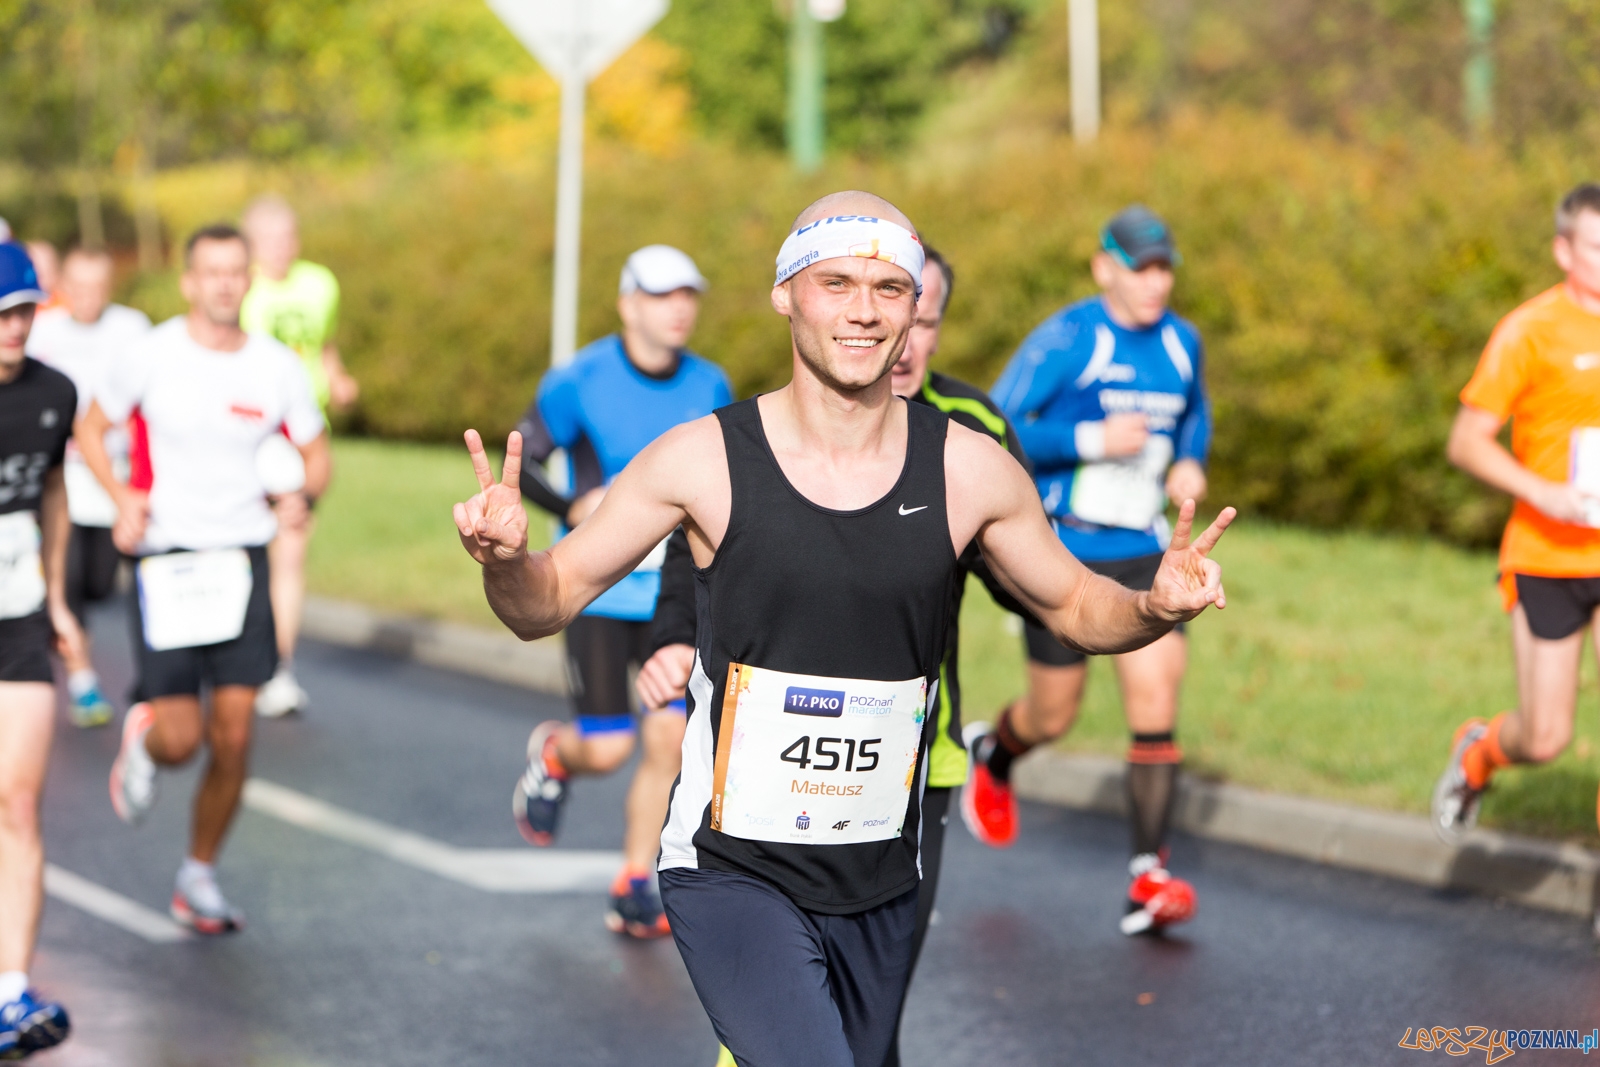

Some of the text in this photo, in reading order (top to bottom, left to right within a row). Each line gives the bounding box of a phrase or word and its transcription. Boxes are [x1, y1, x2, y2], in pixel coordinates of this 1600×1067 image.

[788, 250, 819, 272] energia
[790, 694, 840, 710] 17. PKO
[848, 706, 892, 715] maraton
[780, 735, 882, 772] 4515
[791, 779, 864, 796] Mateusz
[831, 820, 851, 831] 4F
